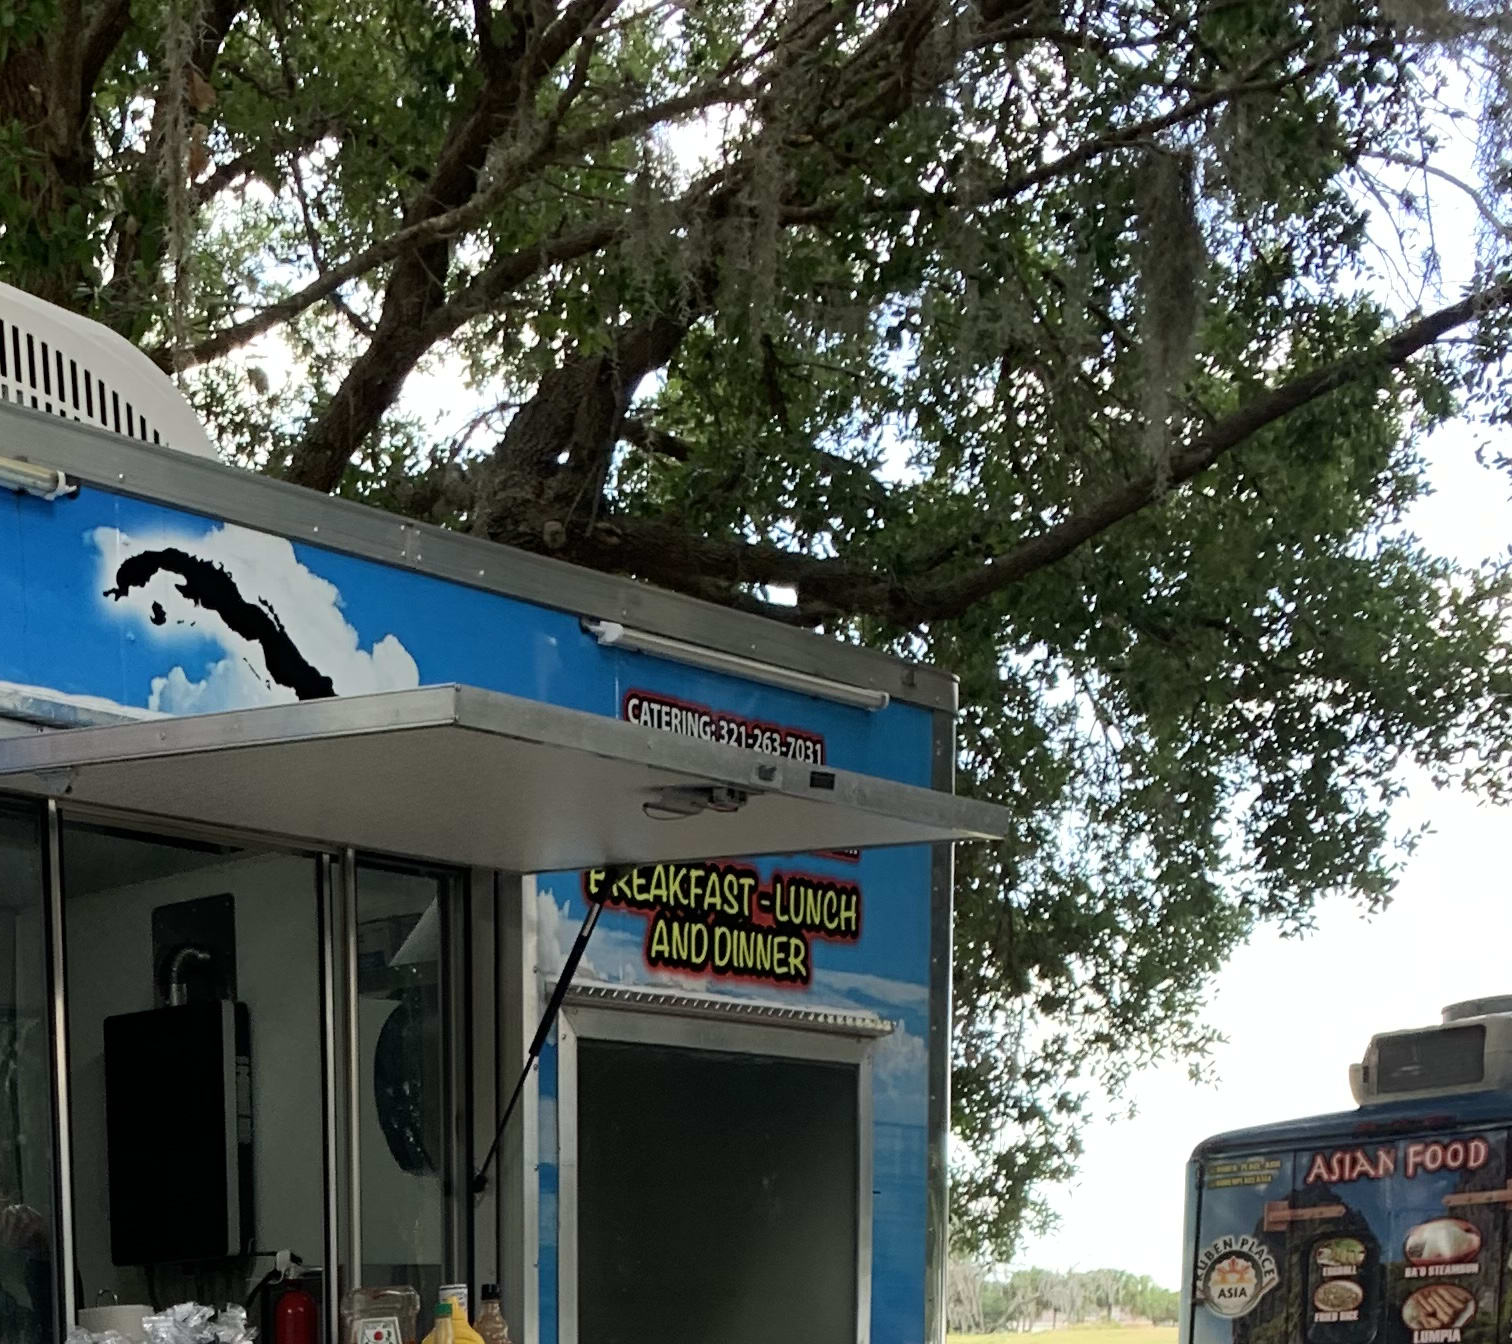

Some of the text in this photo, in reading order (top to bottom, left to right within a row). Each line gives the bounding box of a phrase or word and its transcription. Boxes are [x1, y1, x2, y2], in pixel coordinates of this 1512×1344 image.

[628, 699, 823, 765] CATERING: 321-263-7031
[776, 883, 858, 931] LUNCH
[651, 919, 807, 977] AND DINNER
[1306, 1150, 1395, 1185] ASIAN
[1406, 1139, 1488, 1179] FOOD
[1239, 1237, 1276, 1279] PLACE
[1217, 1286, 1248, 1299] ASIA
[1413, 1327, 1462, 1344] LUMPIA
